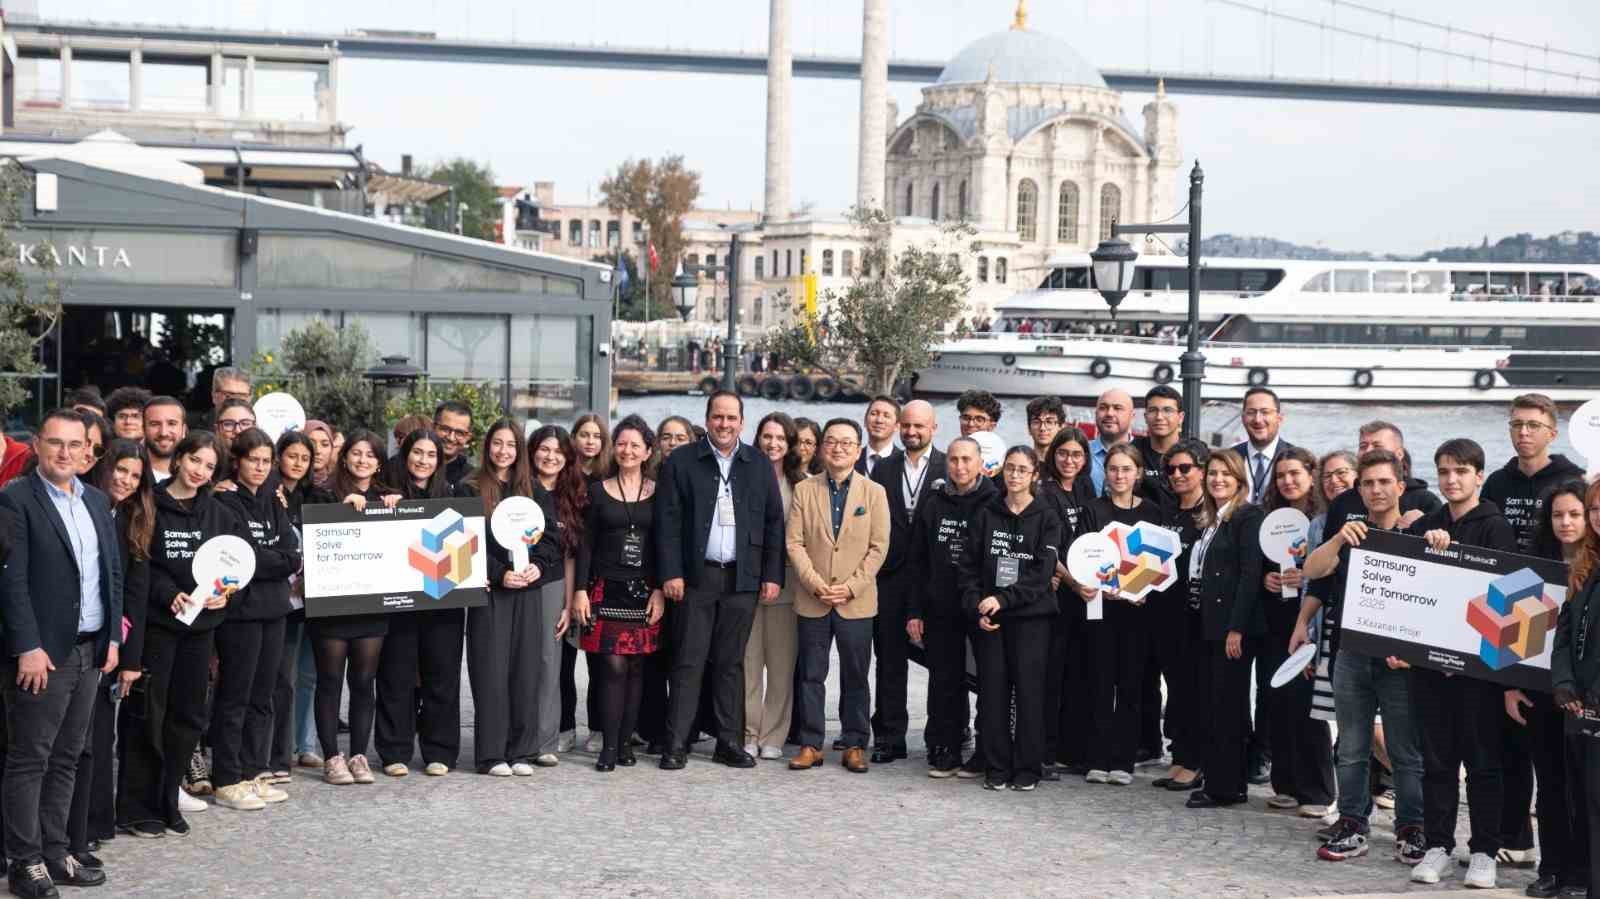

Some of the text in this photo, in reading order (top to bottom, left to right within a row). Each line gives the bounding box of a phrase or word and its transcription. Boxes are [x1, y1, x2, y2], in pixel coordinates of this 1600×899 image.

[164, 530, 201, 540] Samsung
[315, 527, 361, 538] Samsung
[316, 539, 342, 550] Solve
[317, 551, 384, 563] for Tomorrow
[1363, 555, 1417, 577] Samsung
[1361, 569, 1392, 584] Solve
[1360, 582, 1438, 607] for Tomorrow
